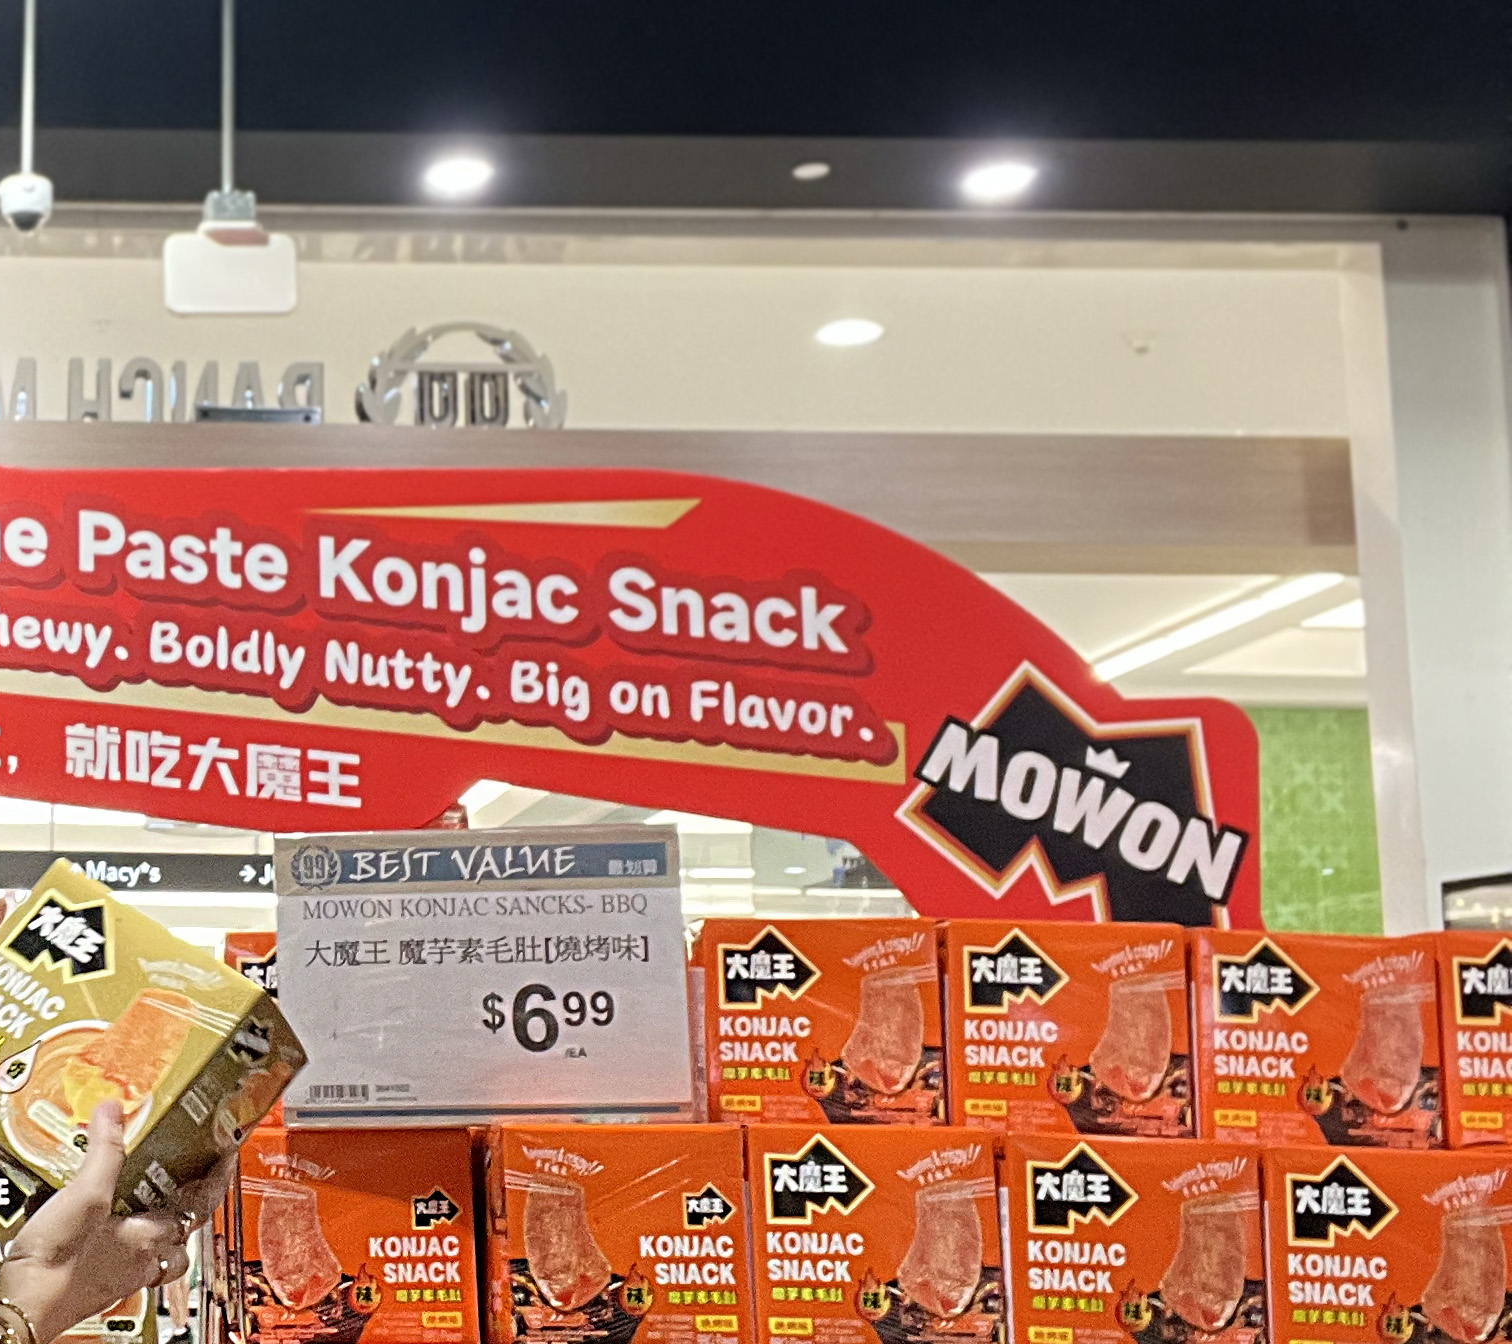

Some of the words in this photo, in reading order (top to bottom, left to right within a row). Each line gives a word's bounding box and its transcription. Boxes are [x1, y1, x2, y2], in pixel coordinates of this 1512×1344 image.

[79, 510, 287, 592] Paste
[319, 535, 579, 633] Konjac
[608, 568, 848, 654] Snack
[149, 622, 305, 690] Boldly
[325, 642, 490, 707] Nutty.
[511, 661, 589, 721] Big
[609, 682, 670, 718] on
[690, 681, 873, 741] Flavor.
[65, 723, 362, 808] 就吃大魔王
[922, 723, 1242, 900] MOWON
[349, 849, 441, 882] BEST
[451, 846, 576, 883] VALUE
[302, 898, 391, 920] MOWON
[401, 897, 488, 916] KONJAC
[495, 895, 593, 915] SANCKS-
[602, 894, 648, 916] BBQ
[305, 939, 388, 967] 大魔王
[719, 1016, 810, 1037] KONJAC
[965, 1020, 1058, 1042] KONJAC
[720, 1042, 798, 1062] SNACK
[1212, 1028, 1307, 1053] KONJAC
[965, 1045, 1045, 1067] SNACK
[1214, 1055, 1294, 1078] SNACK
[370, 1236, 459, 1257] KONJAC
[640, 1236, 733, 1257] KONJAC
[767, 1232, 863, 1255] KONJAC
[1028, 1241, 1125, 1266] KONJAC
[384, 1262, 460, 1283] SNACK
[655, 1263, 735, 1284] SNACK
[768, 1259, 851, 1282] SNACK
[1288, 1254, 1387, 1279] KONJAC
[1029, 1268, 1112, 1293] SNACK
[1289, 1281, 1374, 1306] SNACK
